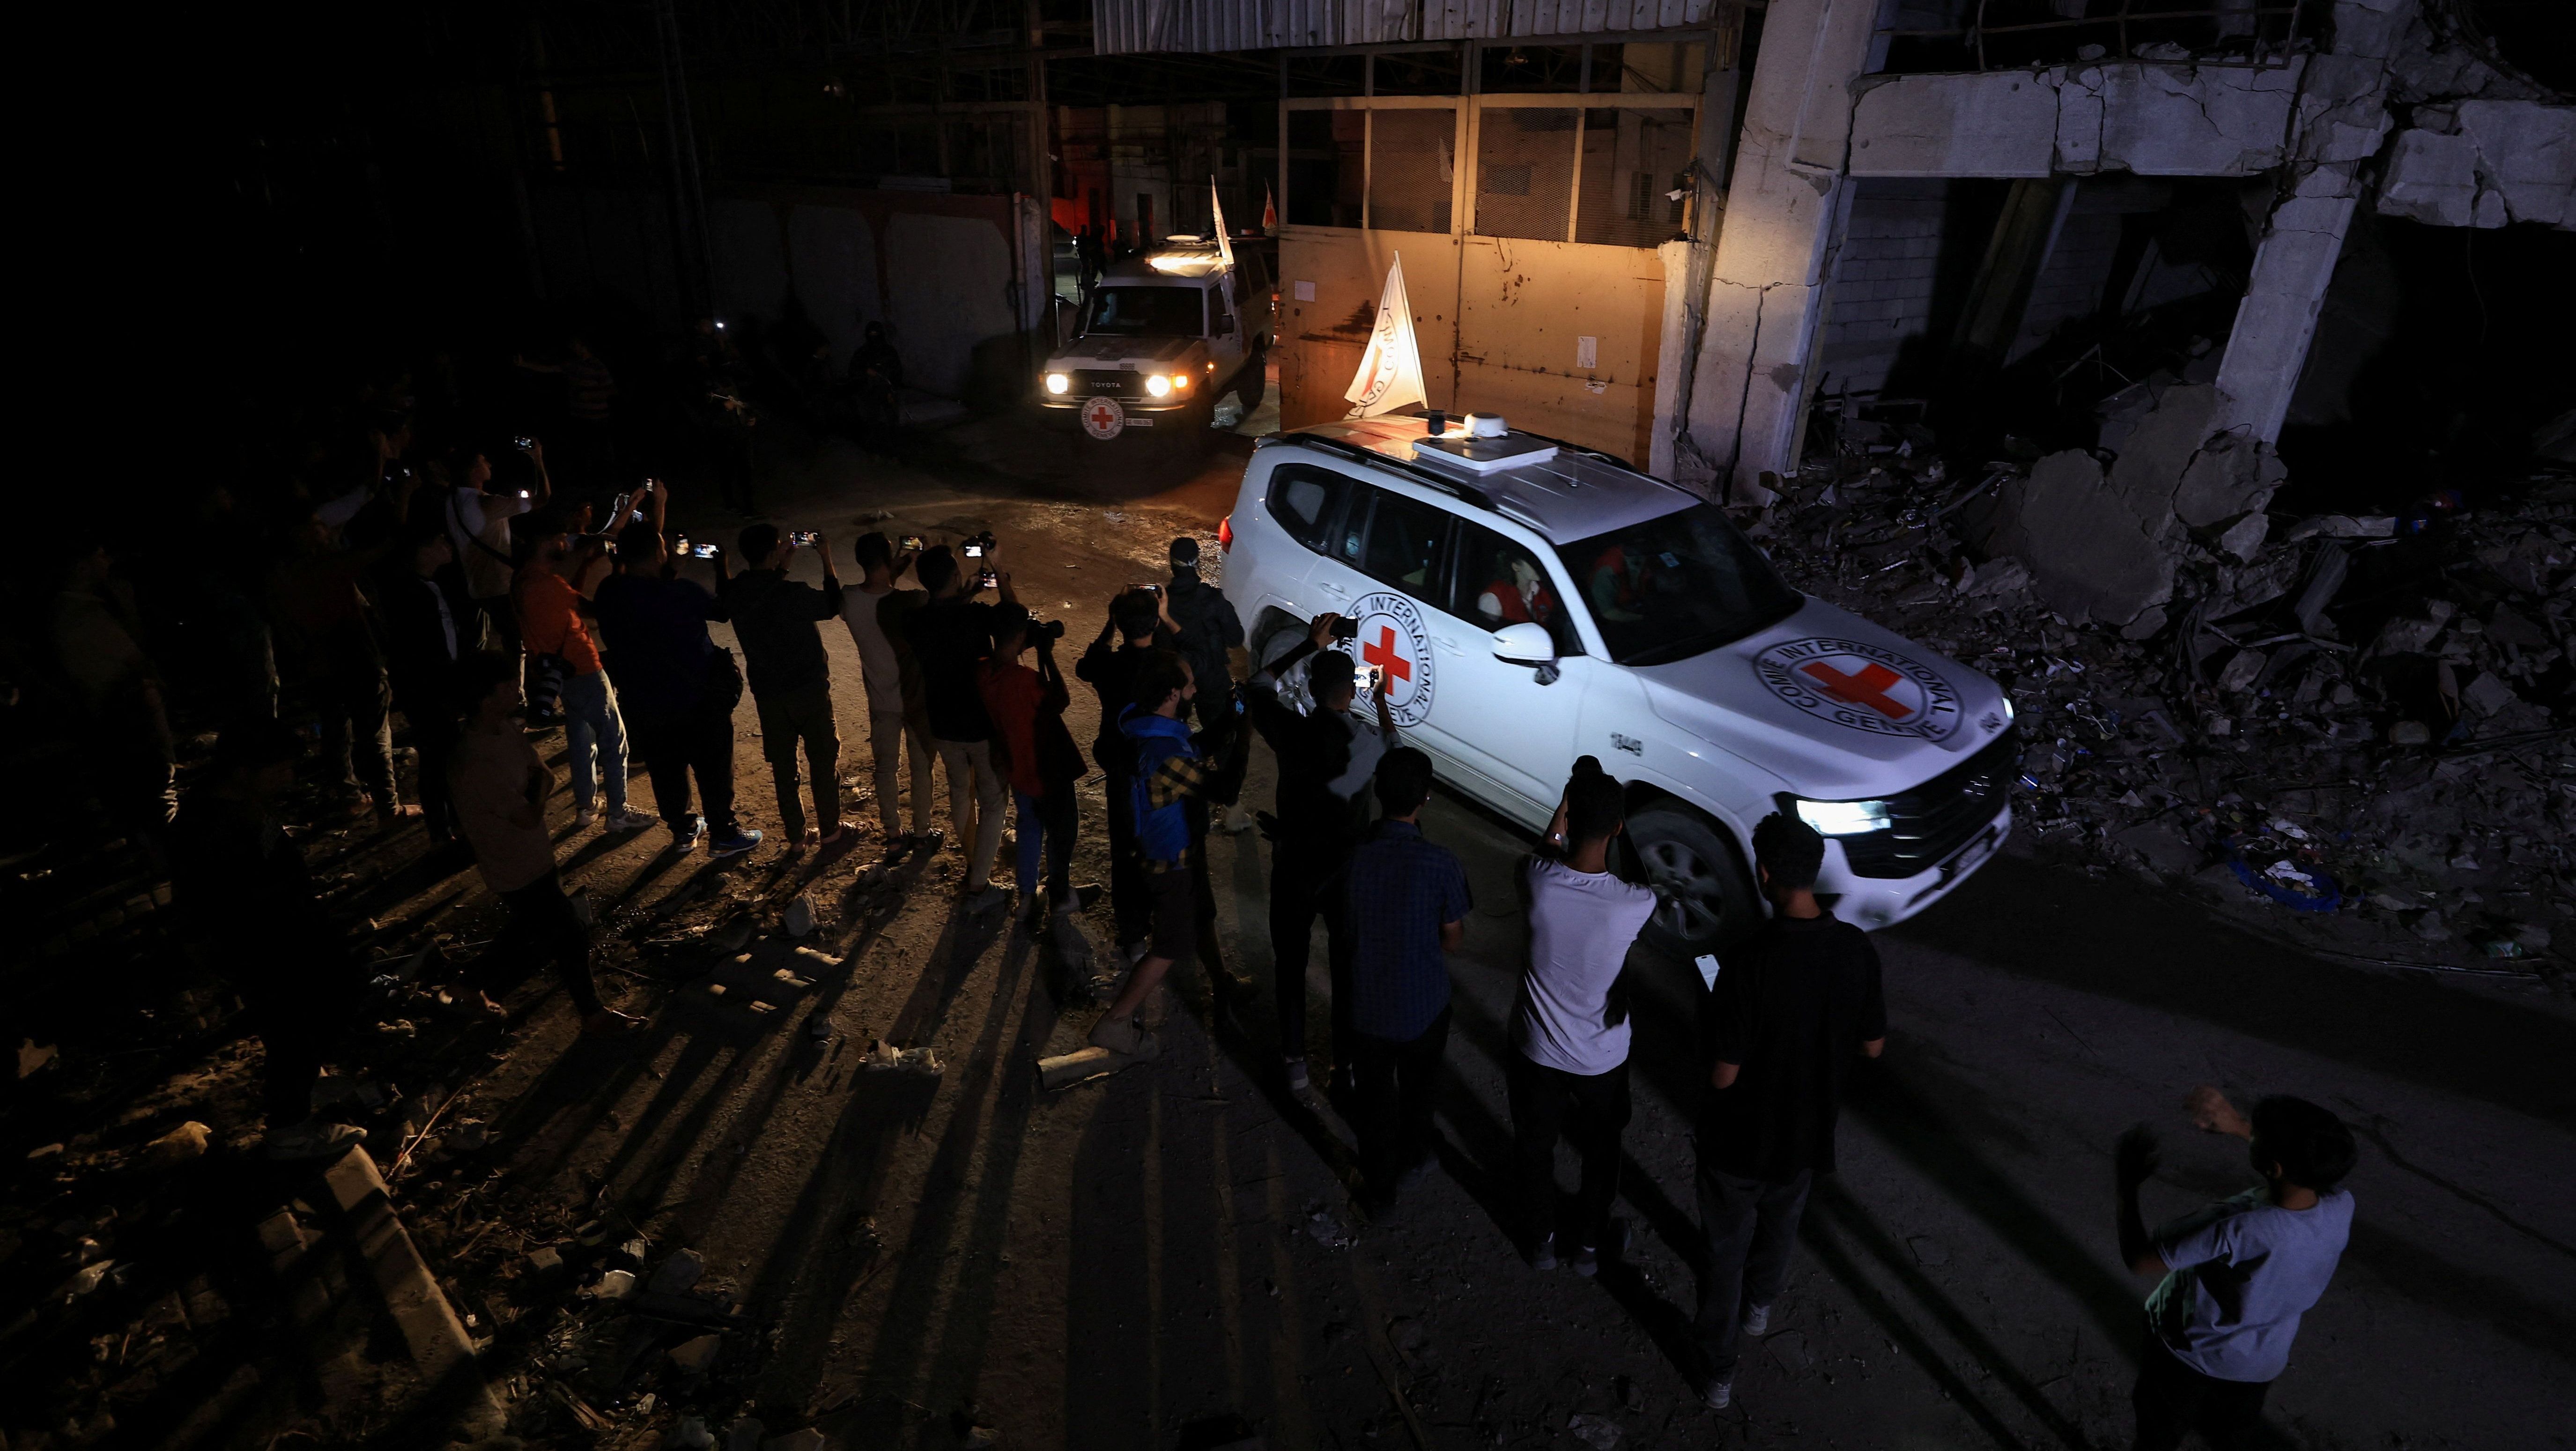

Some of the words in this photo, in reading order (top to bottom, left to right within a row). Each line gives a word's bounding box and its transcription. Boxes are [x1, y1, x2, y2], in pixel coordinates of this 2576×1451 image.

[1370, 597, 1431, 710] INTERNATIONAL
[1776, 640, 1956, 716] INTERNATIONAL
[1359, 687, 1416, 723] GEVE
